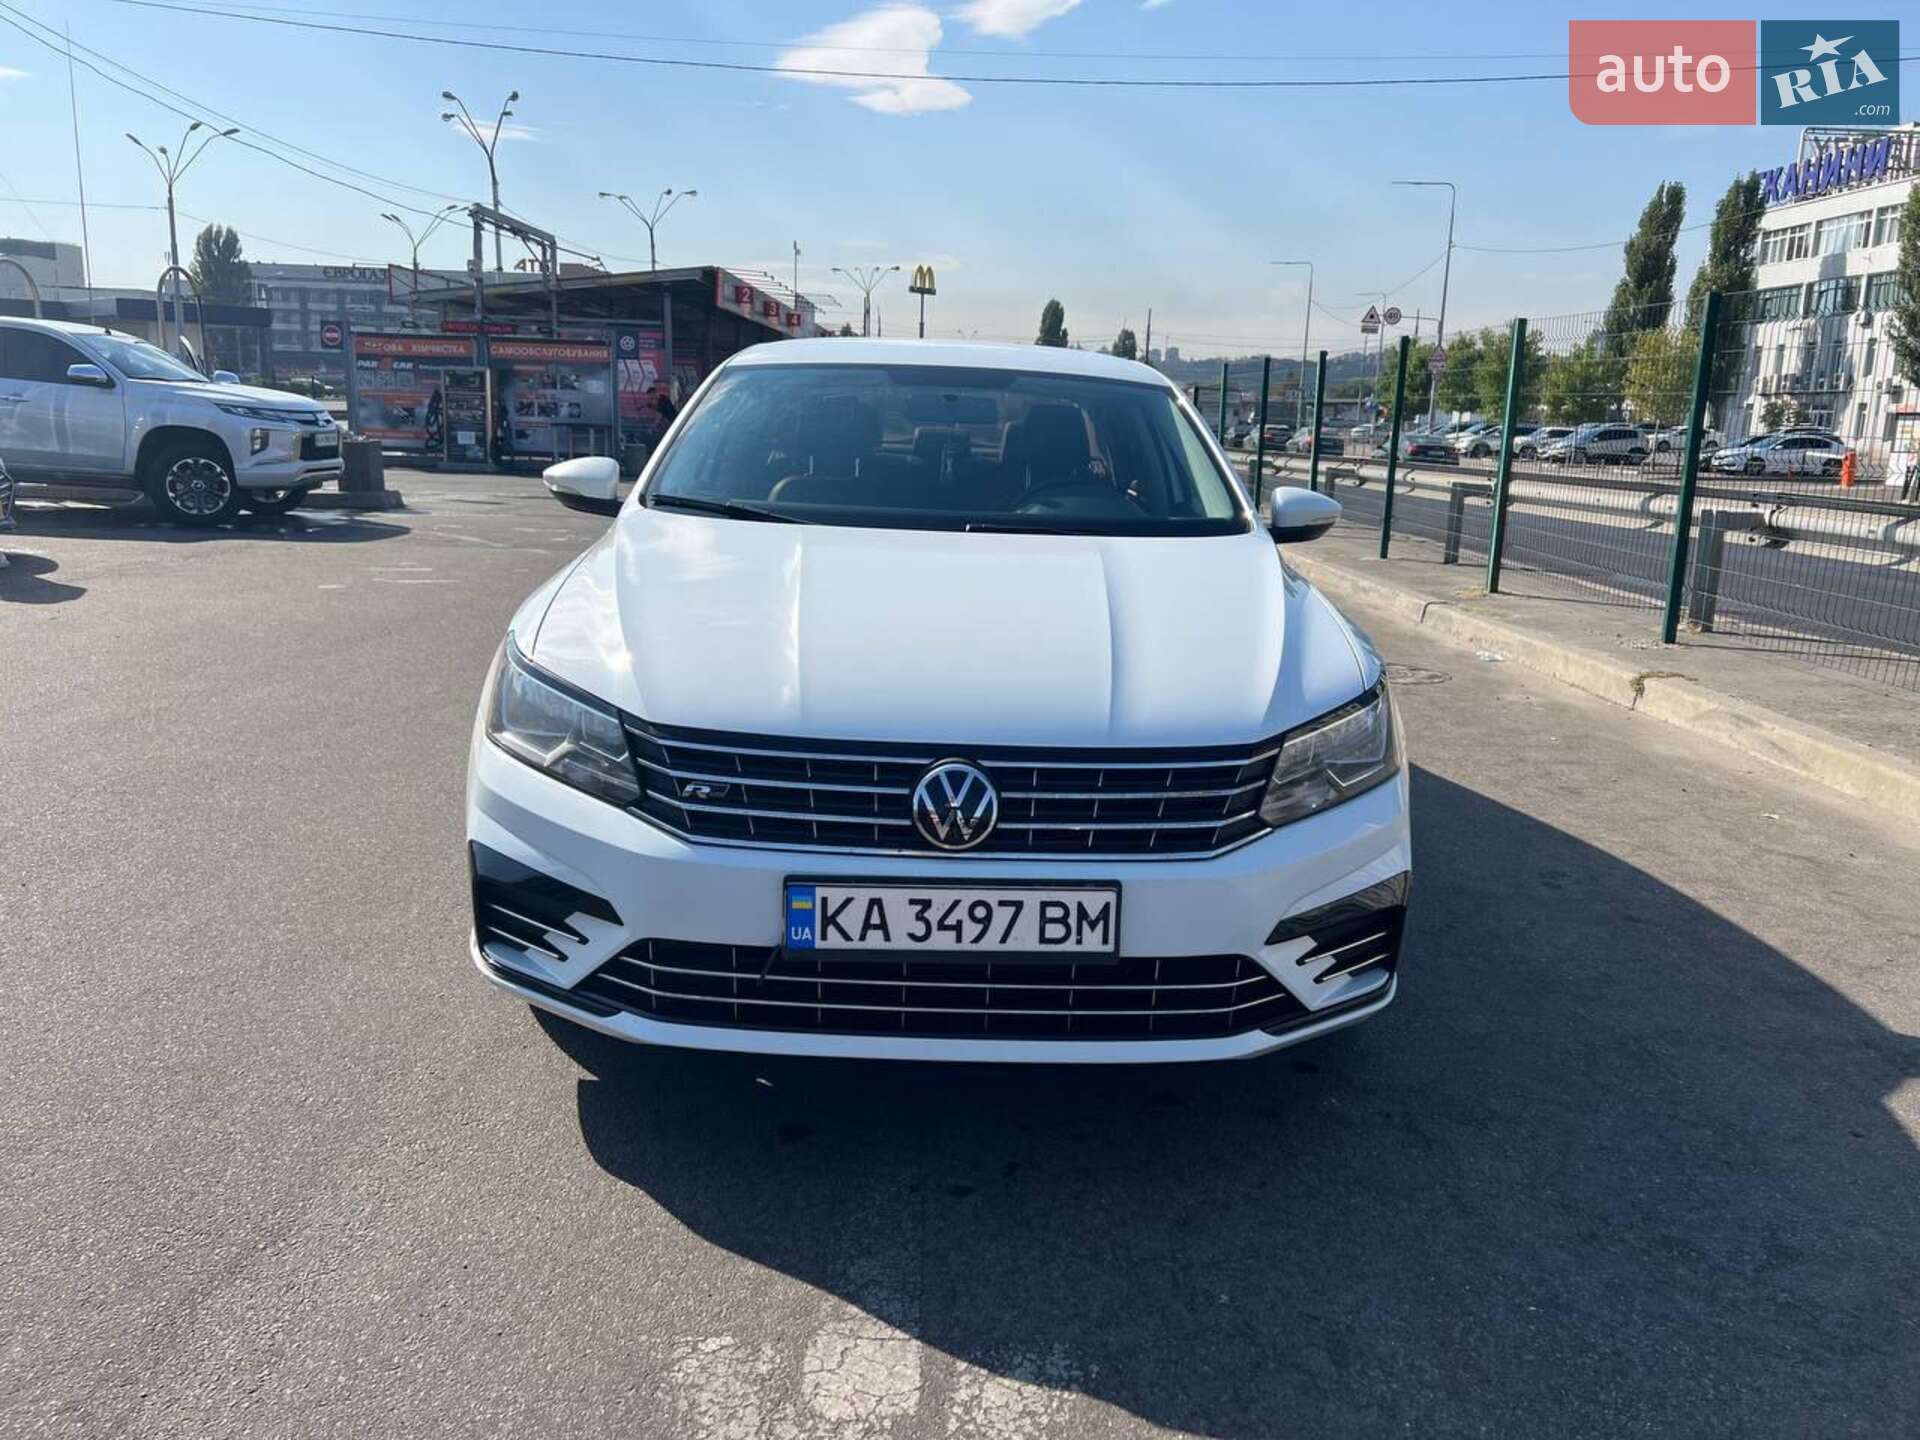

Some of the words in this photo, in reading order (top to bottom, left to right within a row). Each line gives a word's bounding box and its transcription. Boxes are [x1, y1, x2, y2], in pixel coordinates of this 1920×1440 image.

[1757, 138, 1891, 204] КАНИНИ
[742, 287, 751, 302] 2
[768, 302, 778, 315] 3
[1387, 312, 1399, 320] 40
[490, 345, 609, 358] САМООБСЛУГОВУВАННЯ
[820, 896, 892, 943] KA
[906, 898, 1025, 944] 3497
[1038, 900, 1111, 946] BM
[791, 926, 813, 941] UA
